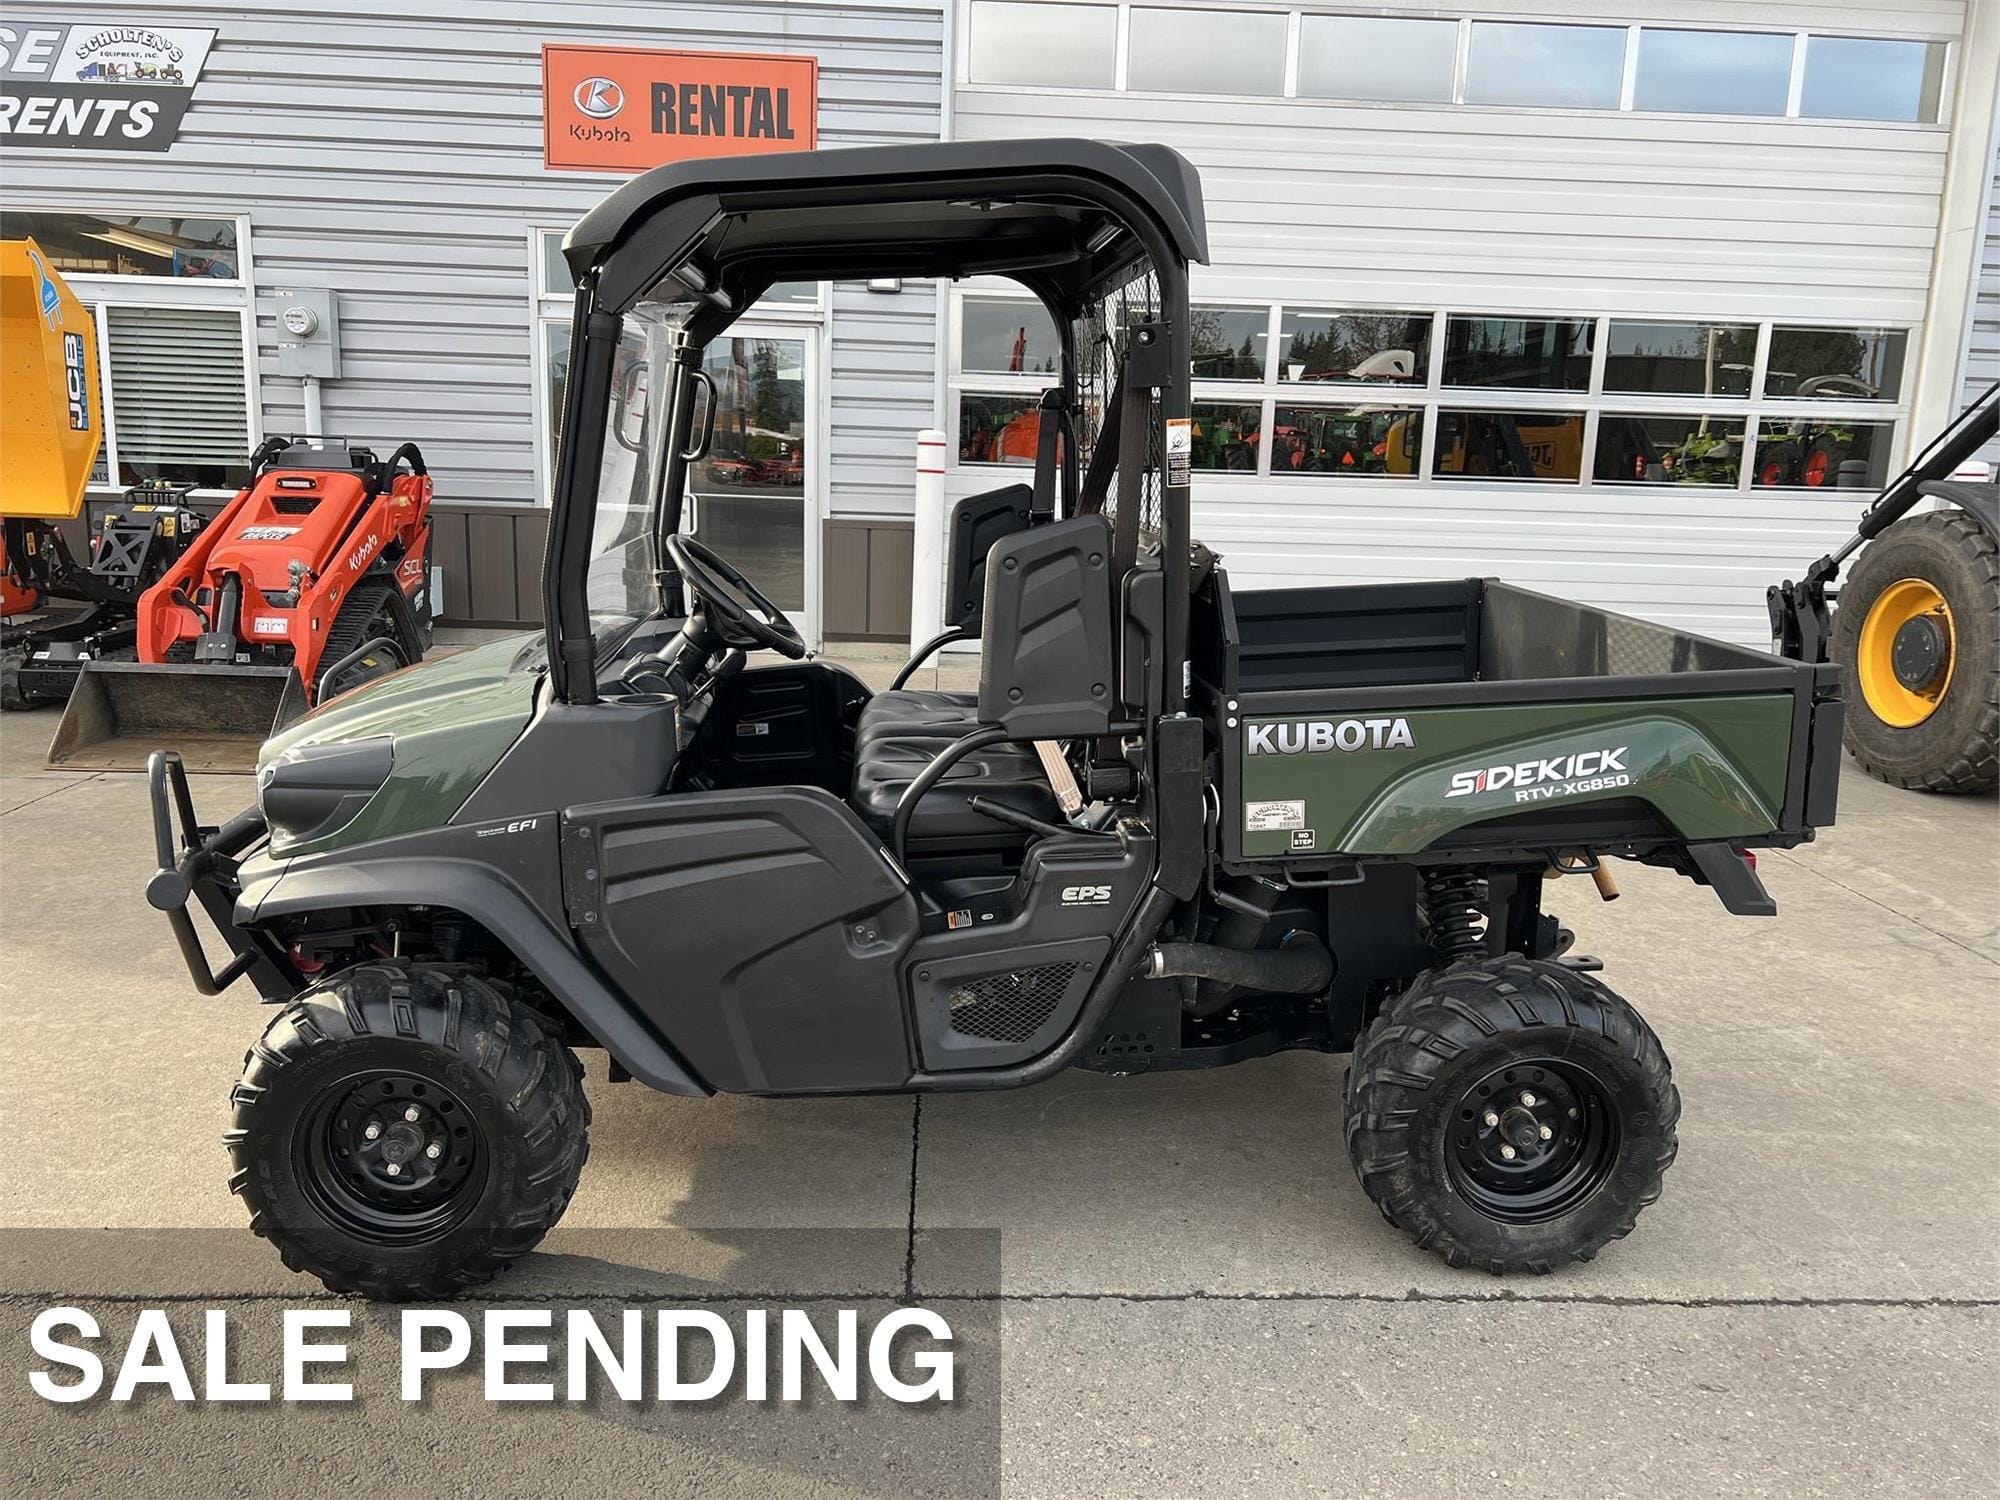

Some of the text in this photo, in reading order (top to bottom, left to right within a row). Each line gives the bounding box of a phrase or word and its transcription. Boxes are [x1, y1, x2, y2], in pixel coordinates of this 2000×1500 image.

[76, 28, 184, 63] SCHOLTEN'S
[651, 82, 795, 140] RENTAL
[569, 124, 631, 143] Kubota
[64, 334, 83, 429] JCB
[348, 533, 378, 571] Kubota
[1247, 717, 1416, 755] KUBOTA
[1444, 746, 1629, 798] SIDEKICK
[1515, 774, 1630, 803] RTV-XG850
[507, 819, 537, 833] EFI
[1061, 885, 1112, 901] EPS
